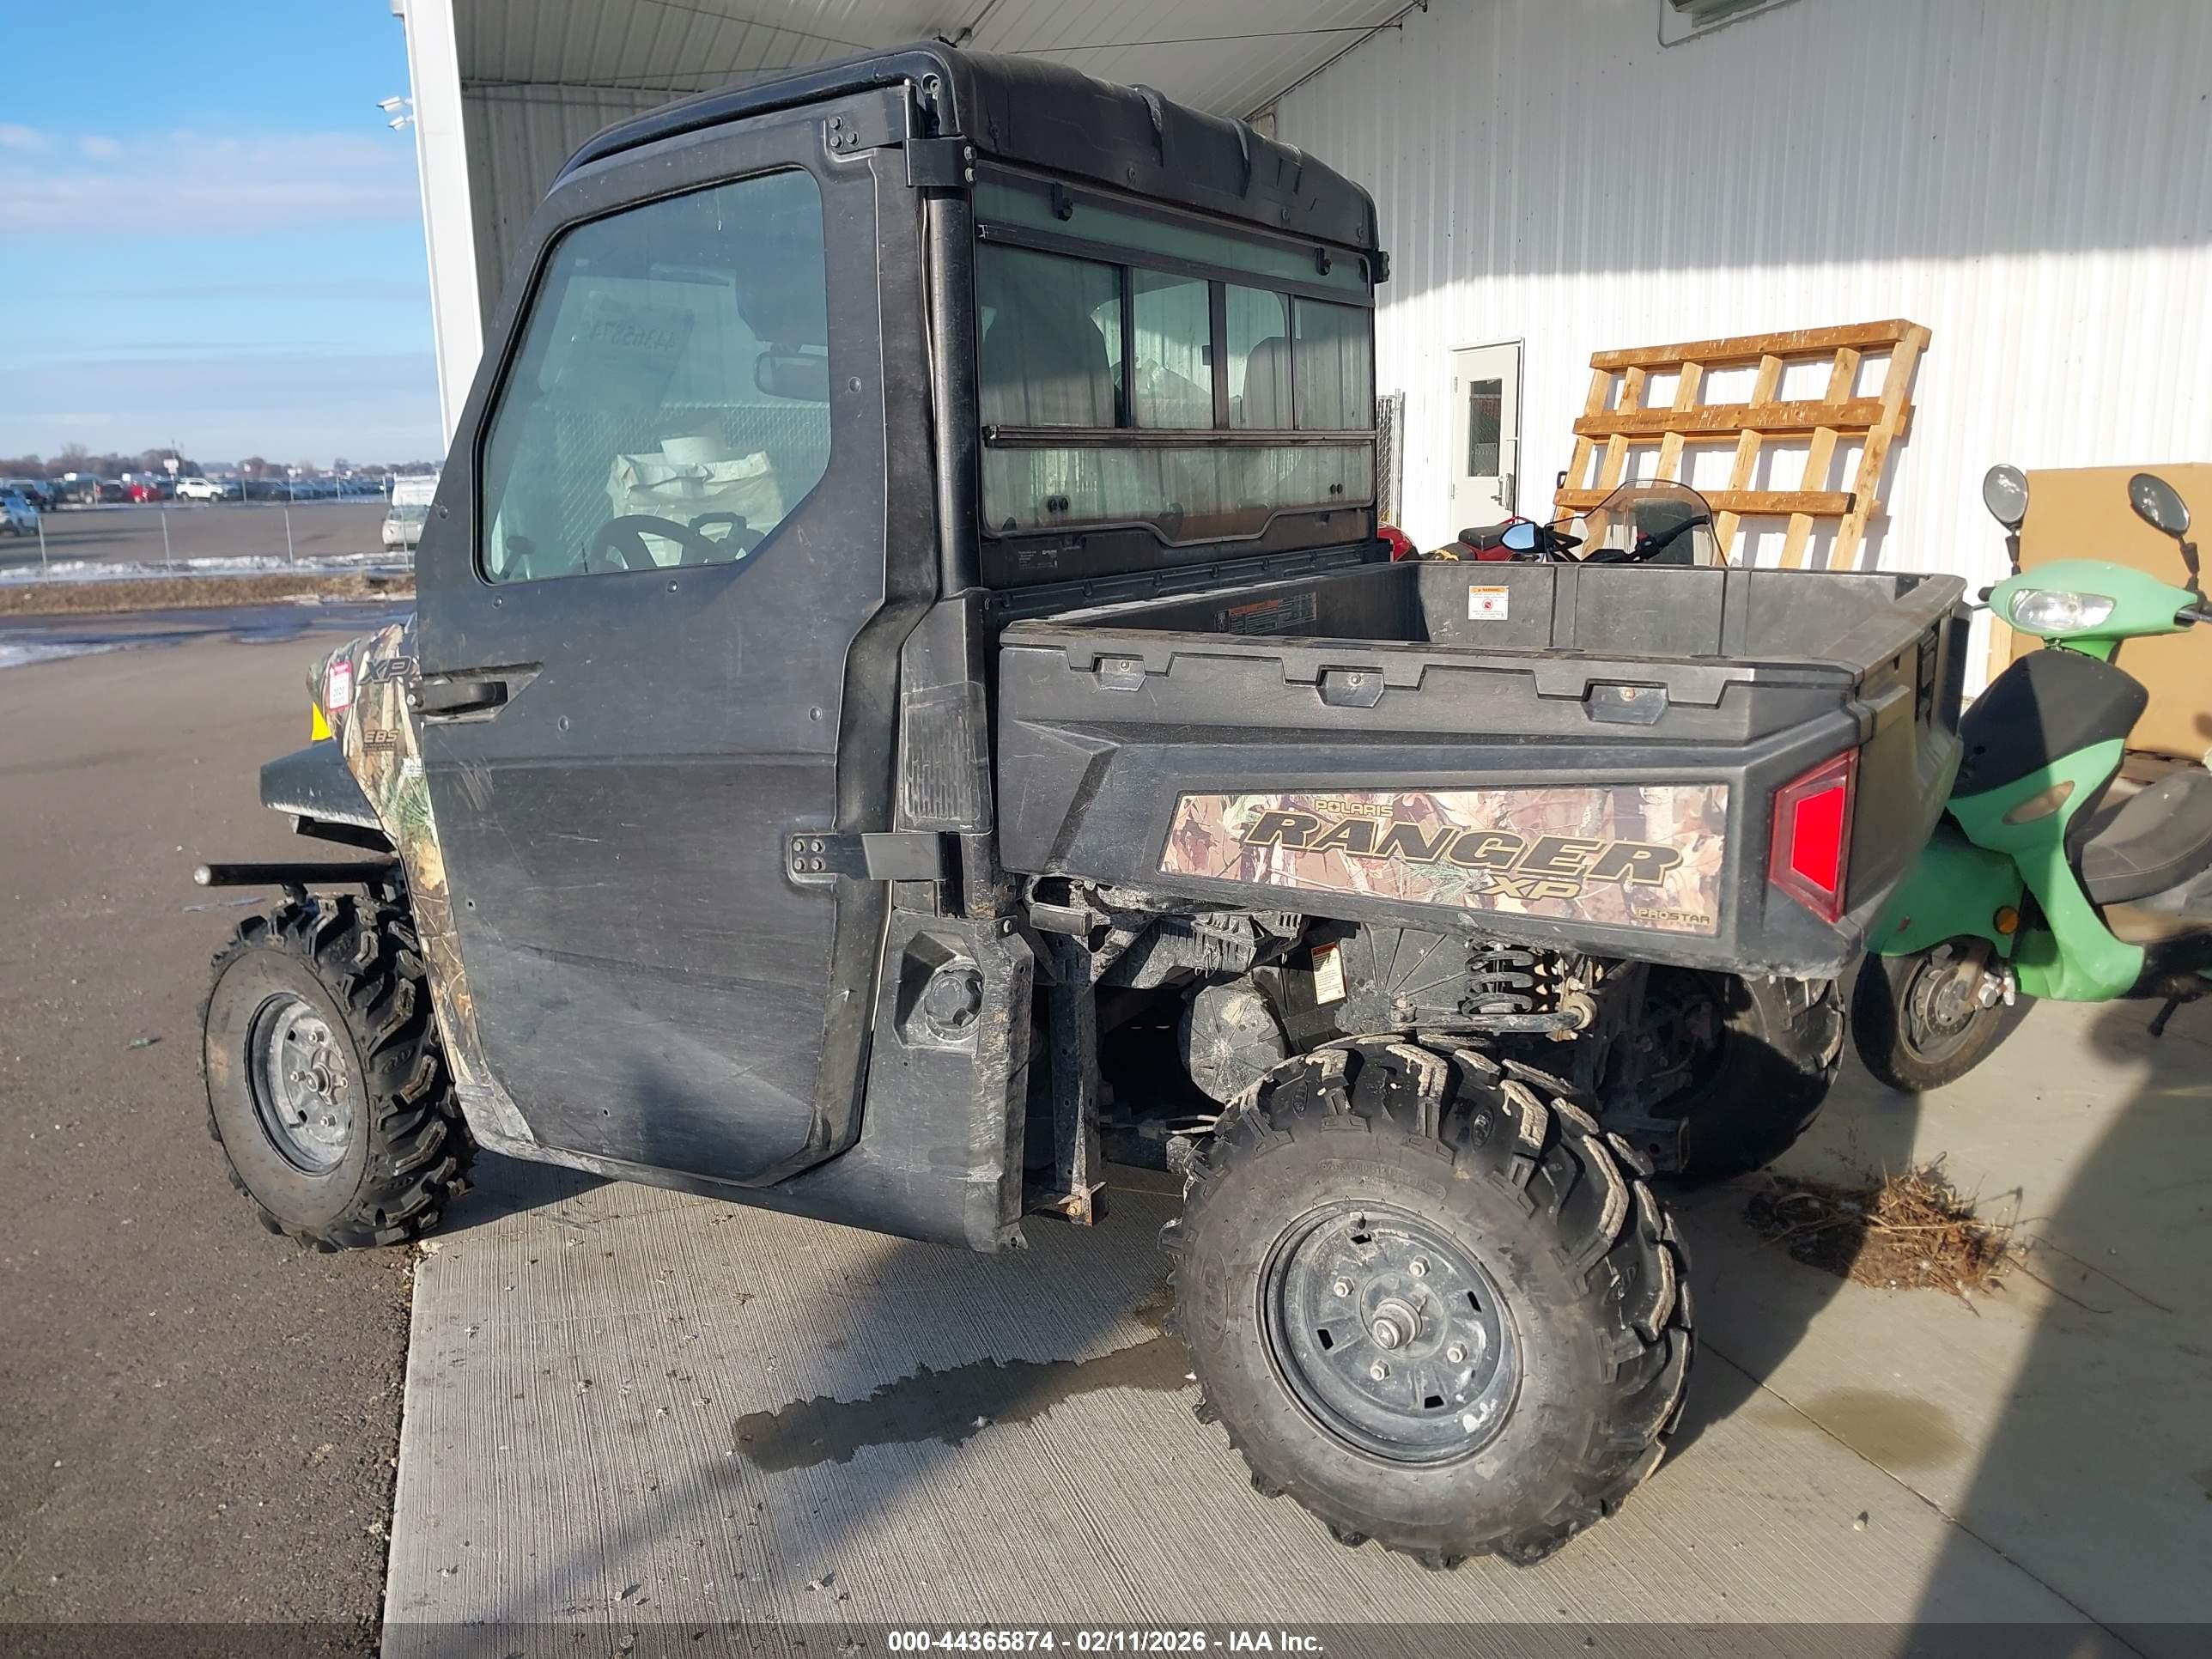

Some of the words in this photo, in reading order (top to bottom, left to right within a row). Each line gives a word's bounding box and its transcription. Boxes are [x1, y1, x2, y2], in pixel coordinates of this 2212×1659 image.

[357, 656, 411, 684] XP
[363, 730, 399, 744] EBS
[1315, 799, 1394, 817] POLARIS
[1244, 810, 1684, 887] RANGER
[1468, 873, 1582, 902] XP
